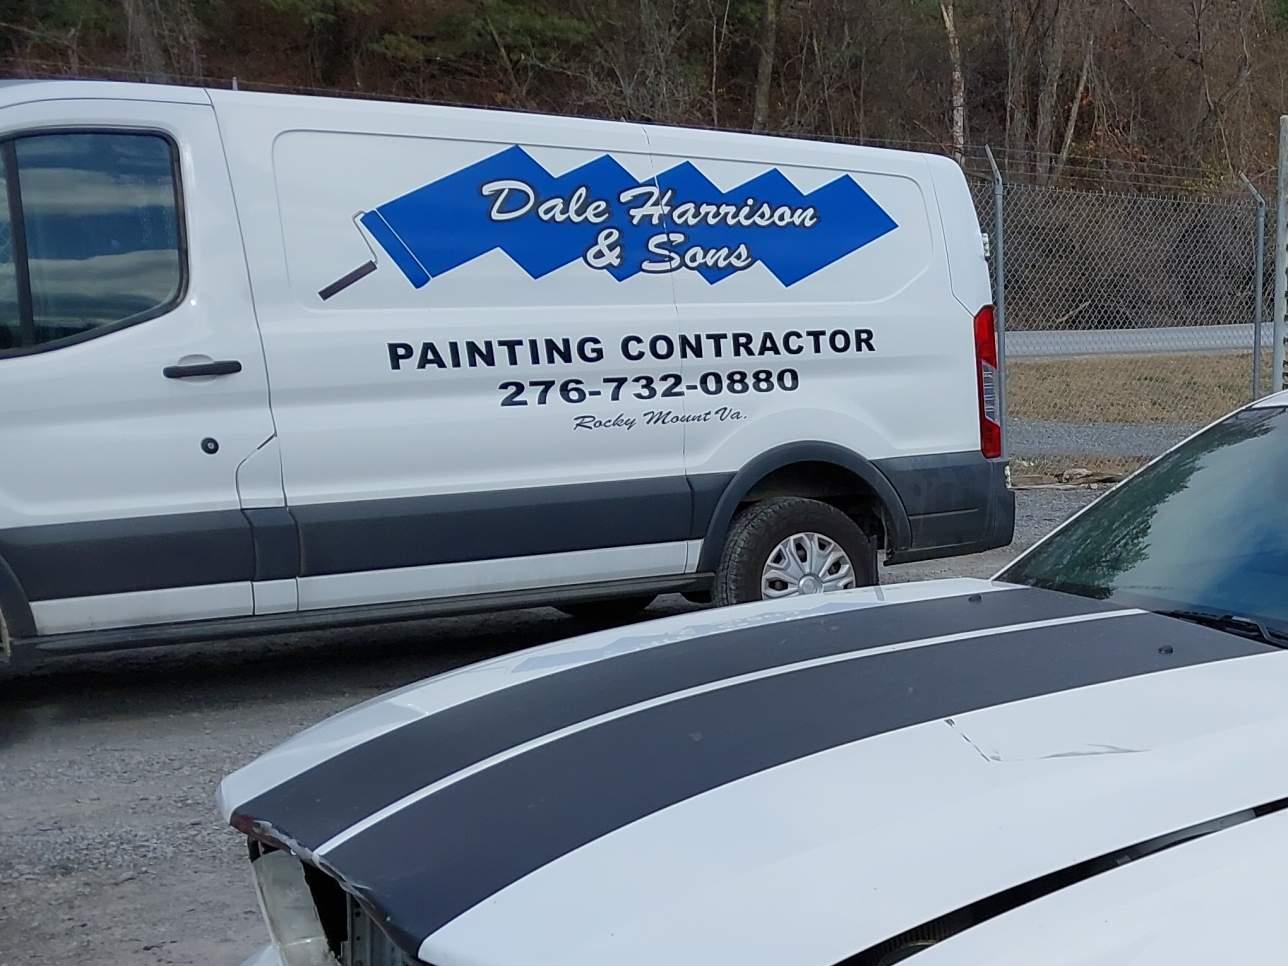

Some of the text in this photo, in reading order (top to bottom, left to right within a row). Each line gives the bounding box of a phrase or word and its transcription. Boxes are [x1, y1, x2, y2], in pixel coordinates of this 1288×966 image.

[481, 179, 817, 228] Dale Harrison
[586, 228, 752, 272] & Sons
[387, 328, 877, 370] PAINTING CONTRACTOR
[498, 367, 801, 408] 276-732-0880
[573, 406, 748, 431] Rocky Mount Va.
